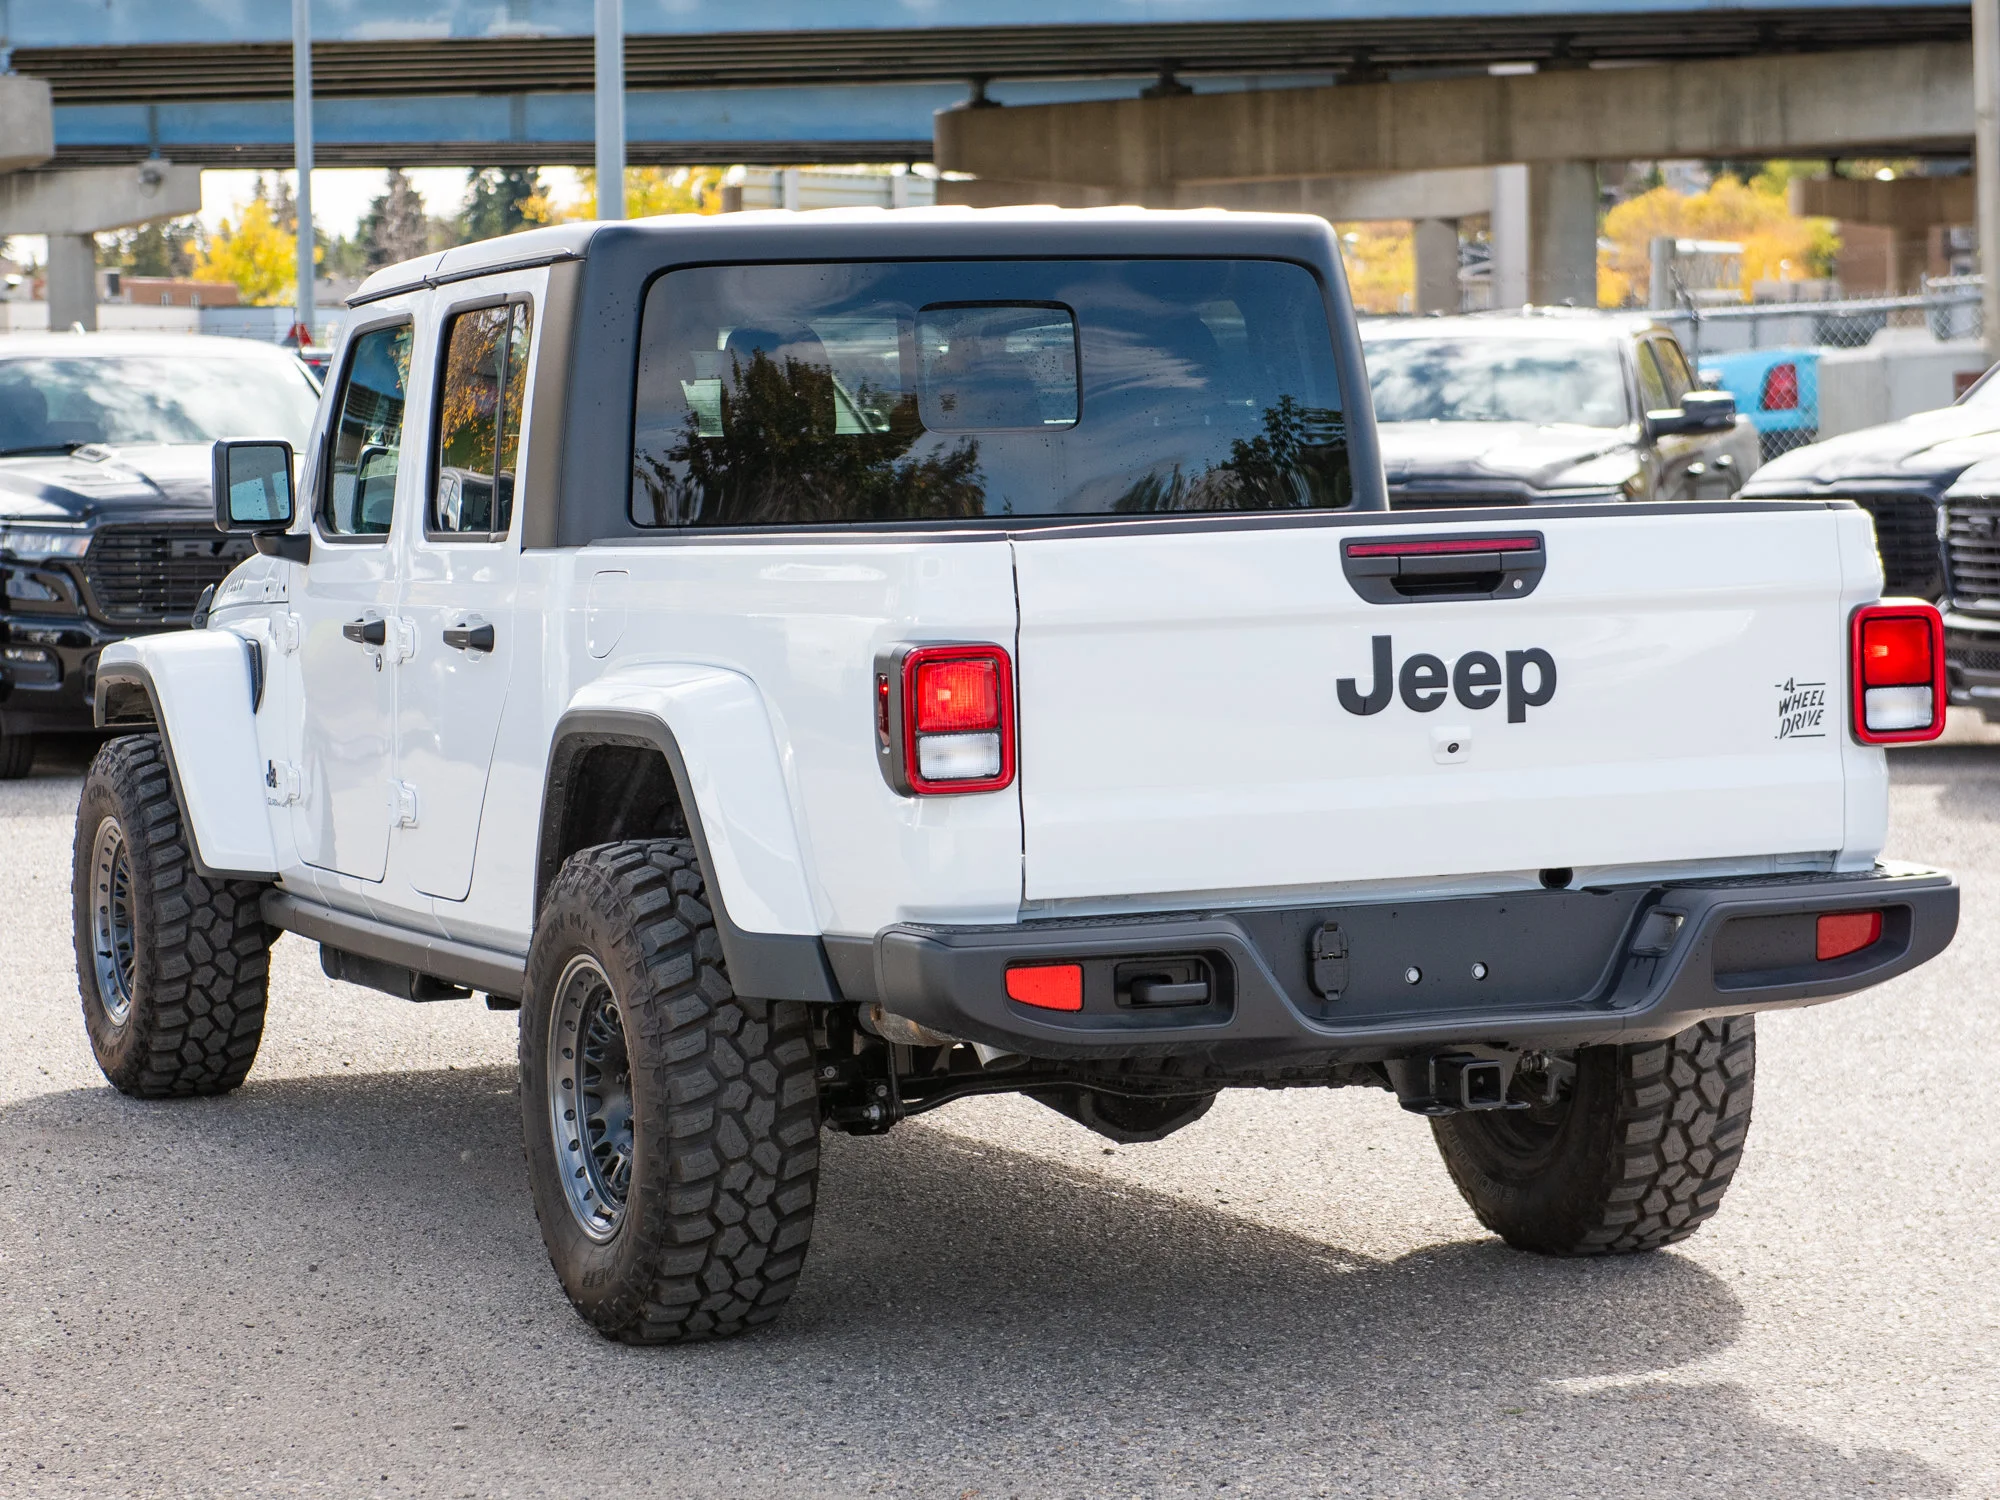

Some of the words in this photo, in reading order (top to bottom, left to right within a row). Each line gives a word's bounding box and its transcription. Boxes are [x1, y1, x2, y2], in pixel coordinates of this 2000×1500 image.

[171, 538, 258, 558] RA
[1336, 635, 1557, 724] Jeep
[1783, 677, 1795, 694] 4
[1779, 690, 1825, 718] WHEEL
[1779, 709, 1825, 740] DRIVE
